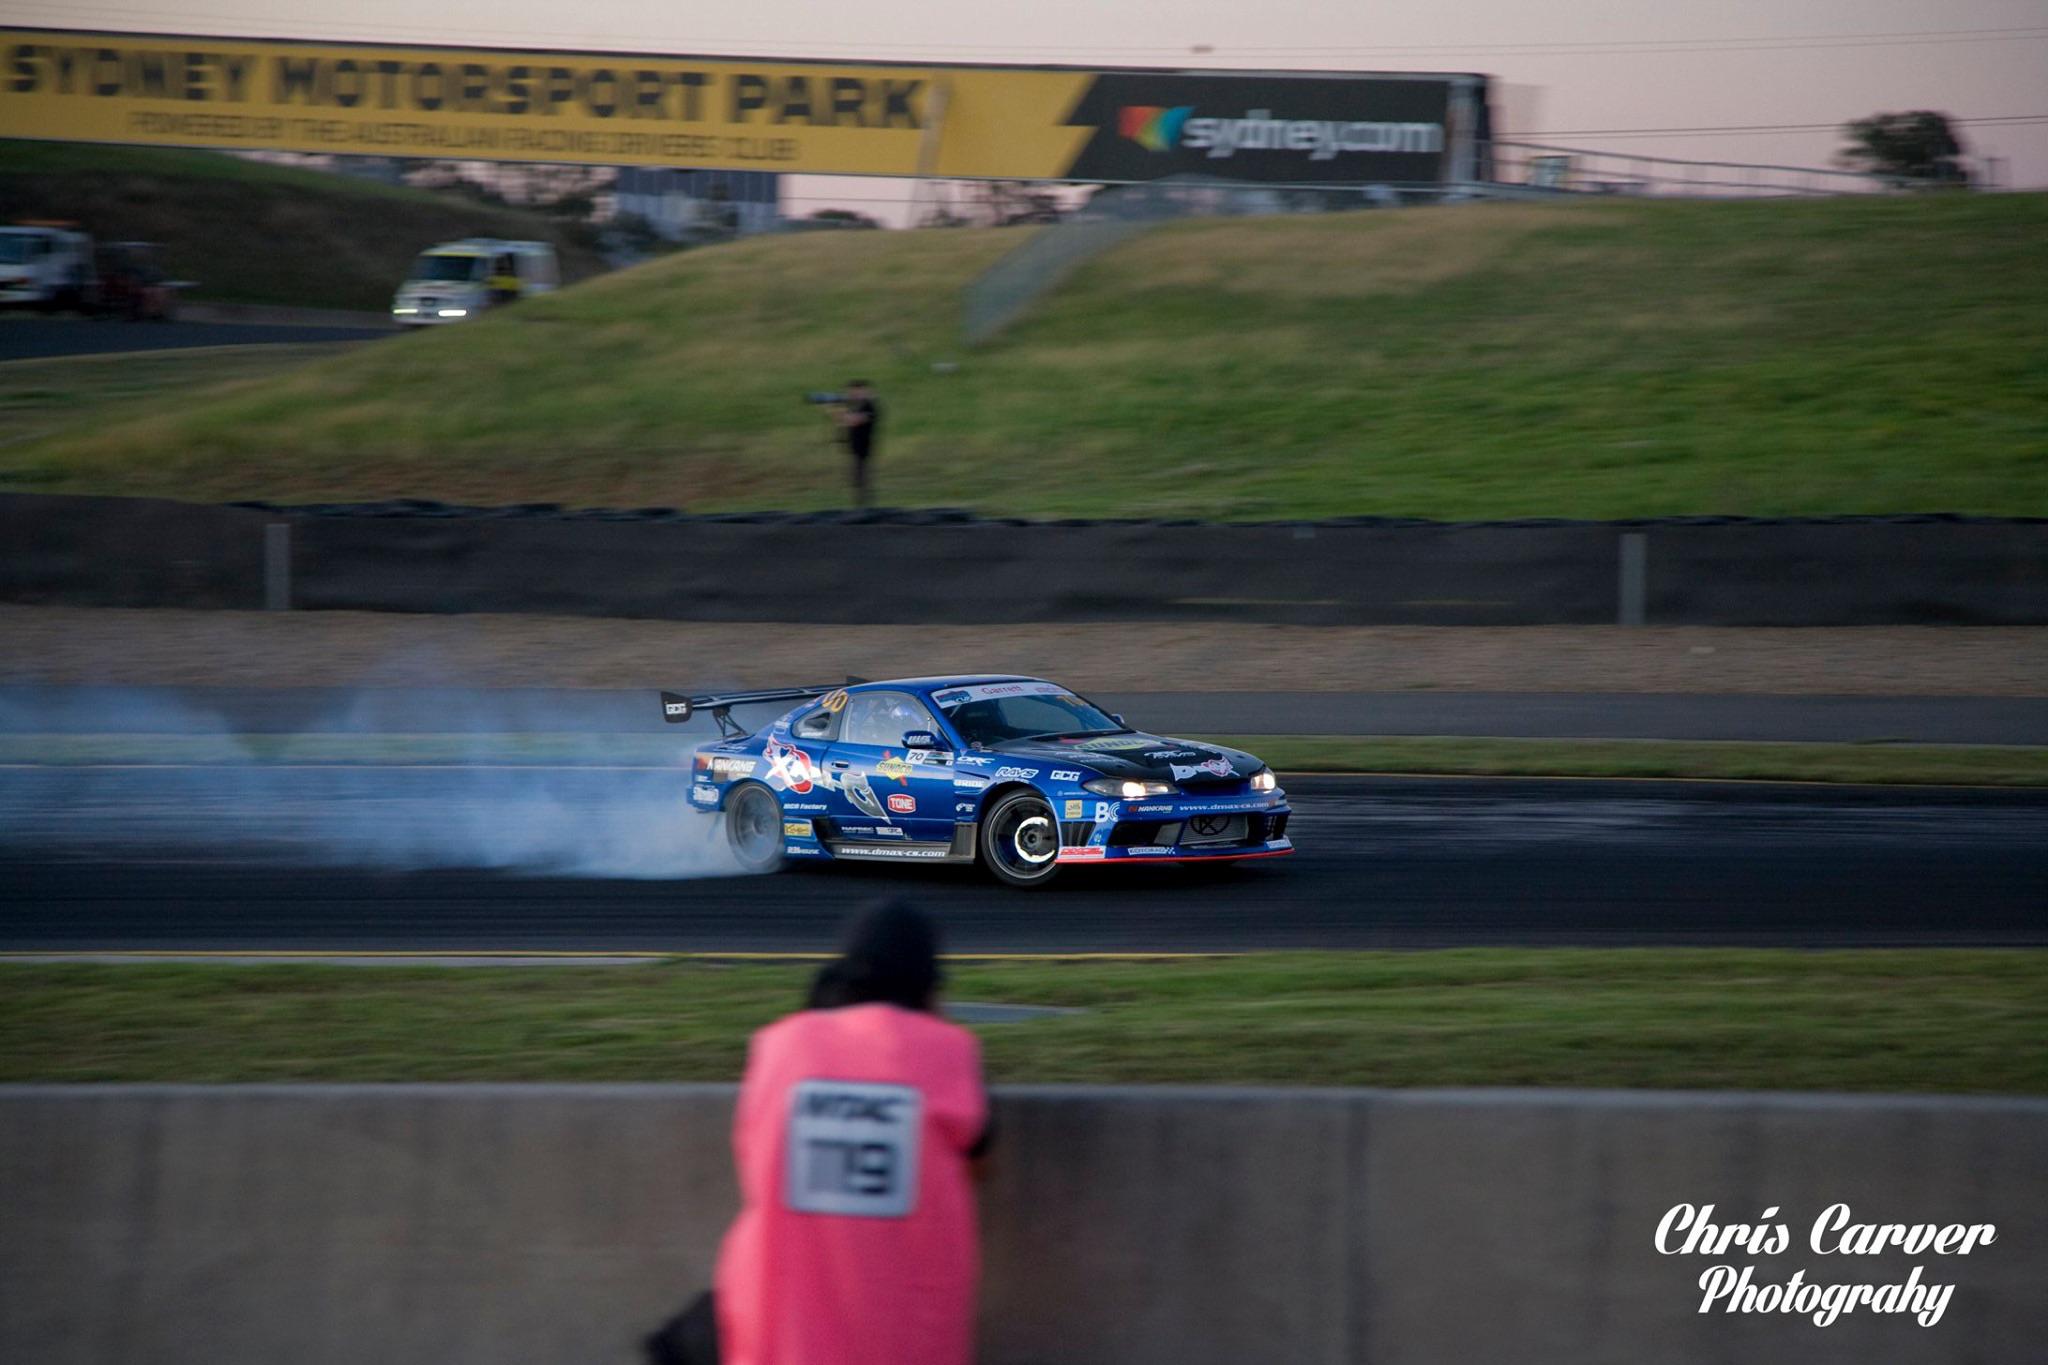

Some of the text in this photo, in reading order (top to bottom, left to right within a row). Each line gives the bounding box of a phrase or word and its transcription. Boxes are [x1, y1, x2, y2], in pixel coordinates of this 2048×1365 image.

[5, 43, 928, 130] SYDNEY MOTORSPORT PARK
[1182, 110, 1442, 159] sydney.com
[981, 685, 1023, 695] Garrett
[909, 752, 924, 761] 70
[995, 766, 1039, 779] RAYS
[1050, 770, 1081, 781] GCG
[889, 797, 914, 809] TONE
[841, 847, 945, 857] www.dmax-cs.com
